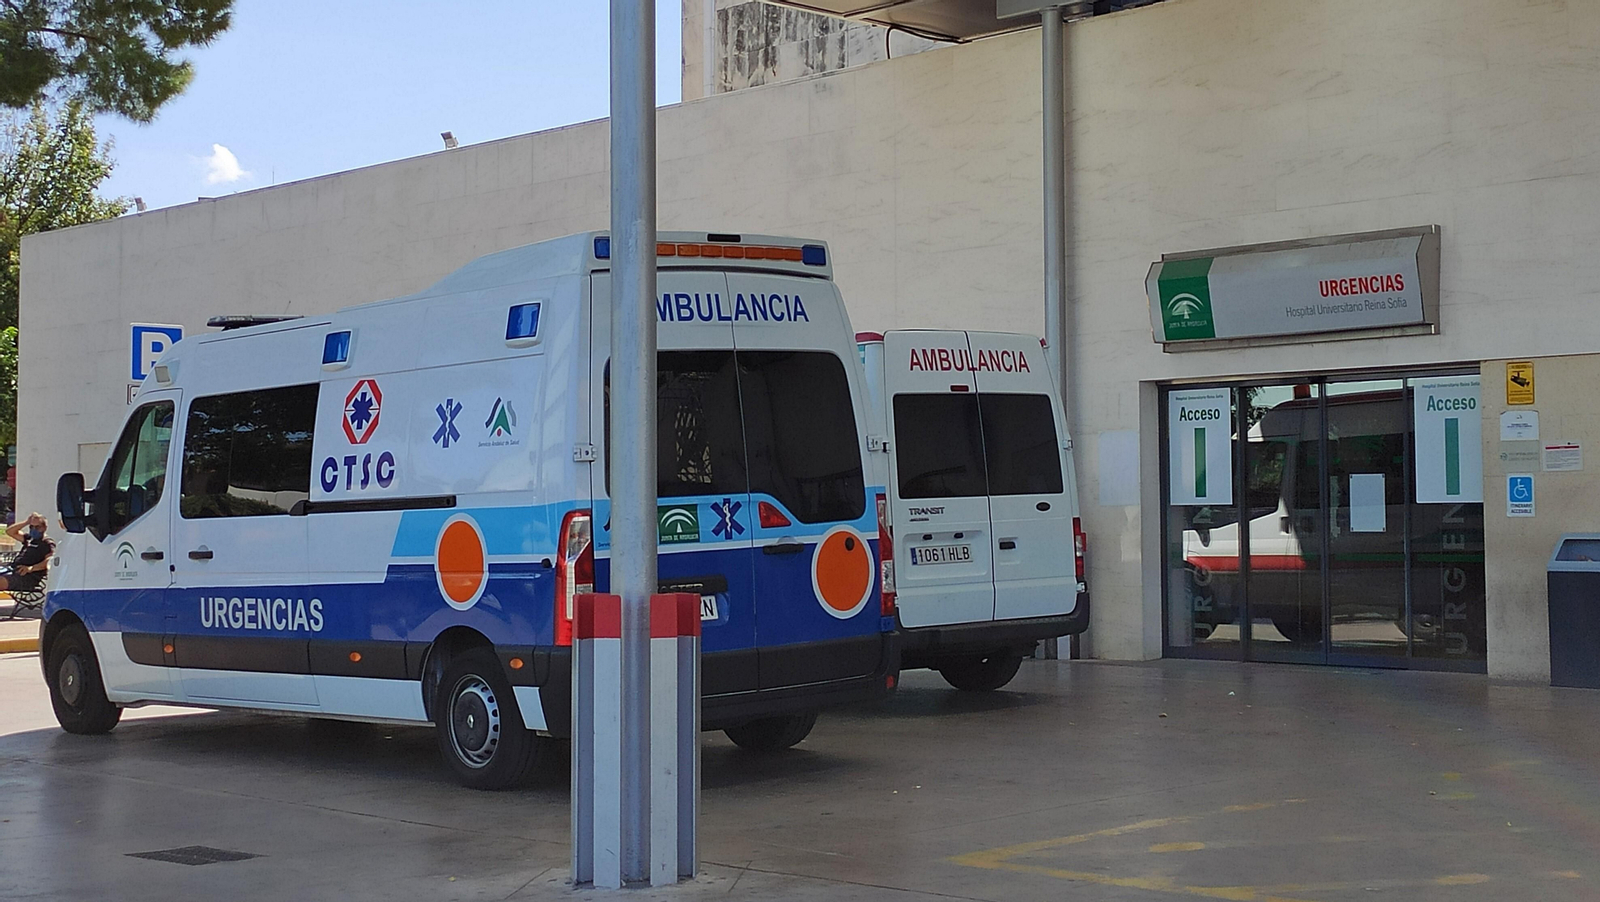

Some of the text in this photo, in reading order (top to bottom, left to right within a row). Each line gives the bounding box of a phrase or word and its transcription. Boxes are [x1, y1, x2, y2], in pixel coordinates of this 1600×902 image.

[1319, 274, 1405, 297] URGENCIAS
[656, 293, 810, 322] MBULANCIA
[1286, 305, 1316, 318] Hospital
[1317, 302, 1363, 315] Universitario
[1364, 299, 1386, 311] Reina
[141, 331, 173, 375] P
[909, 348, 1031, 373] AMBULANCIA
[1179, 406, 1220, 421] Acceso
[1427, 395, 1476, 411] Acceso
[320, 451, 395, 493] CTSC
[908, 506, 945, 515] TRANSIT
[918, 546, 970, 562] 1061 HLB
[200, 597, 324, 632] URGENCIAS
